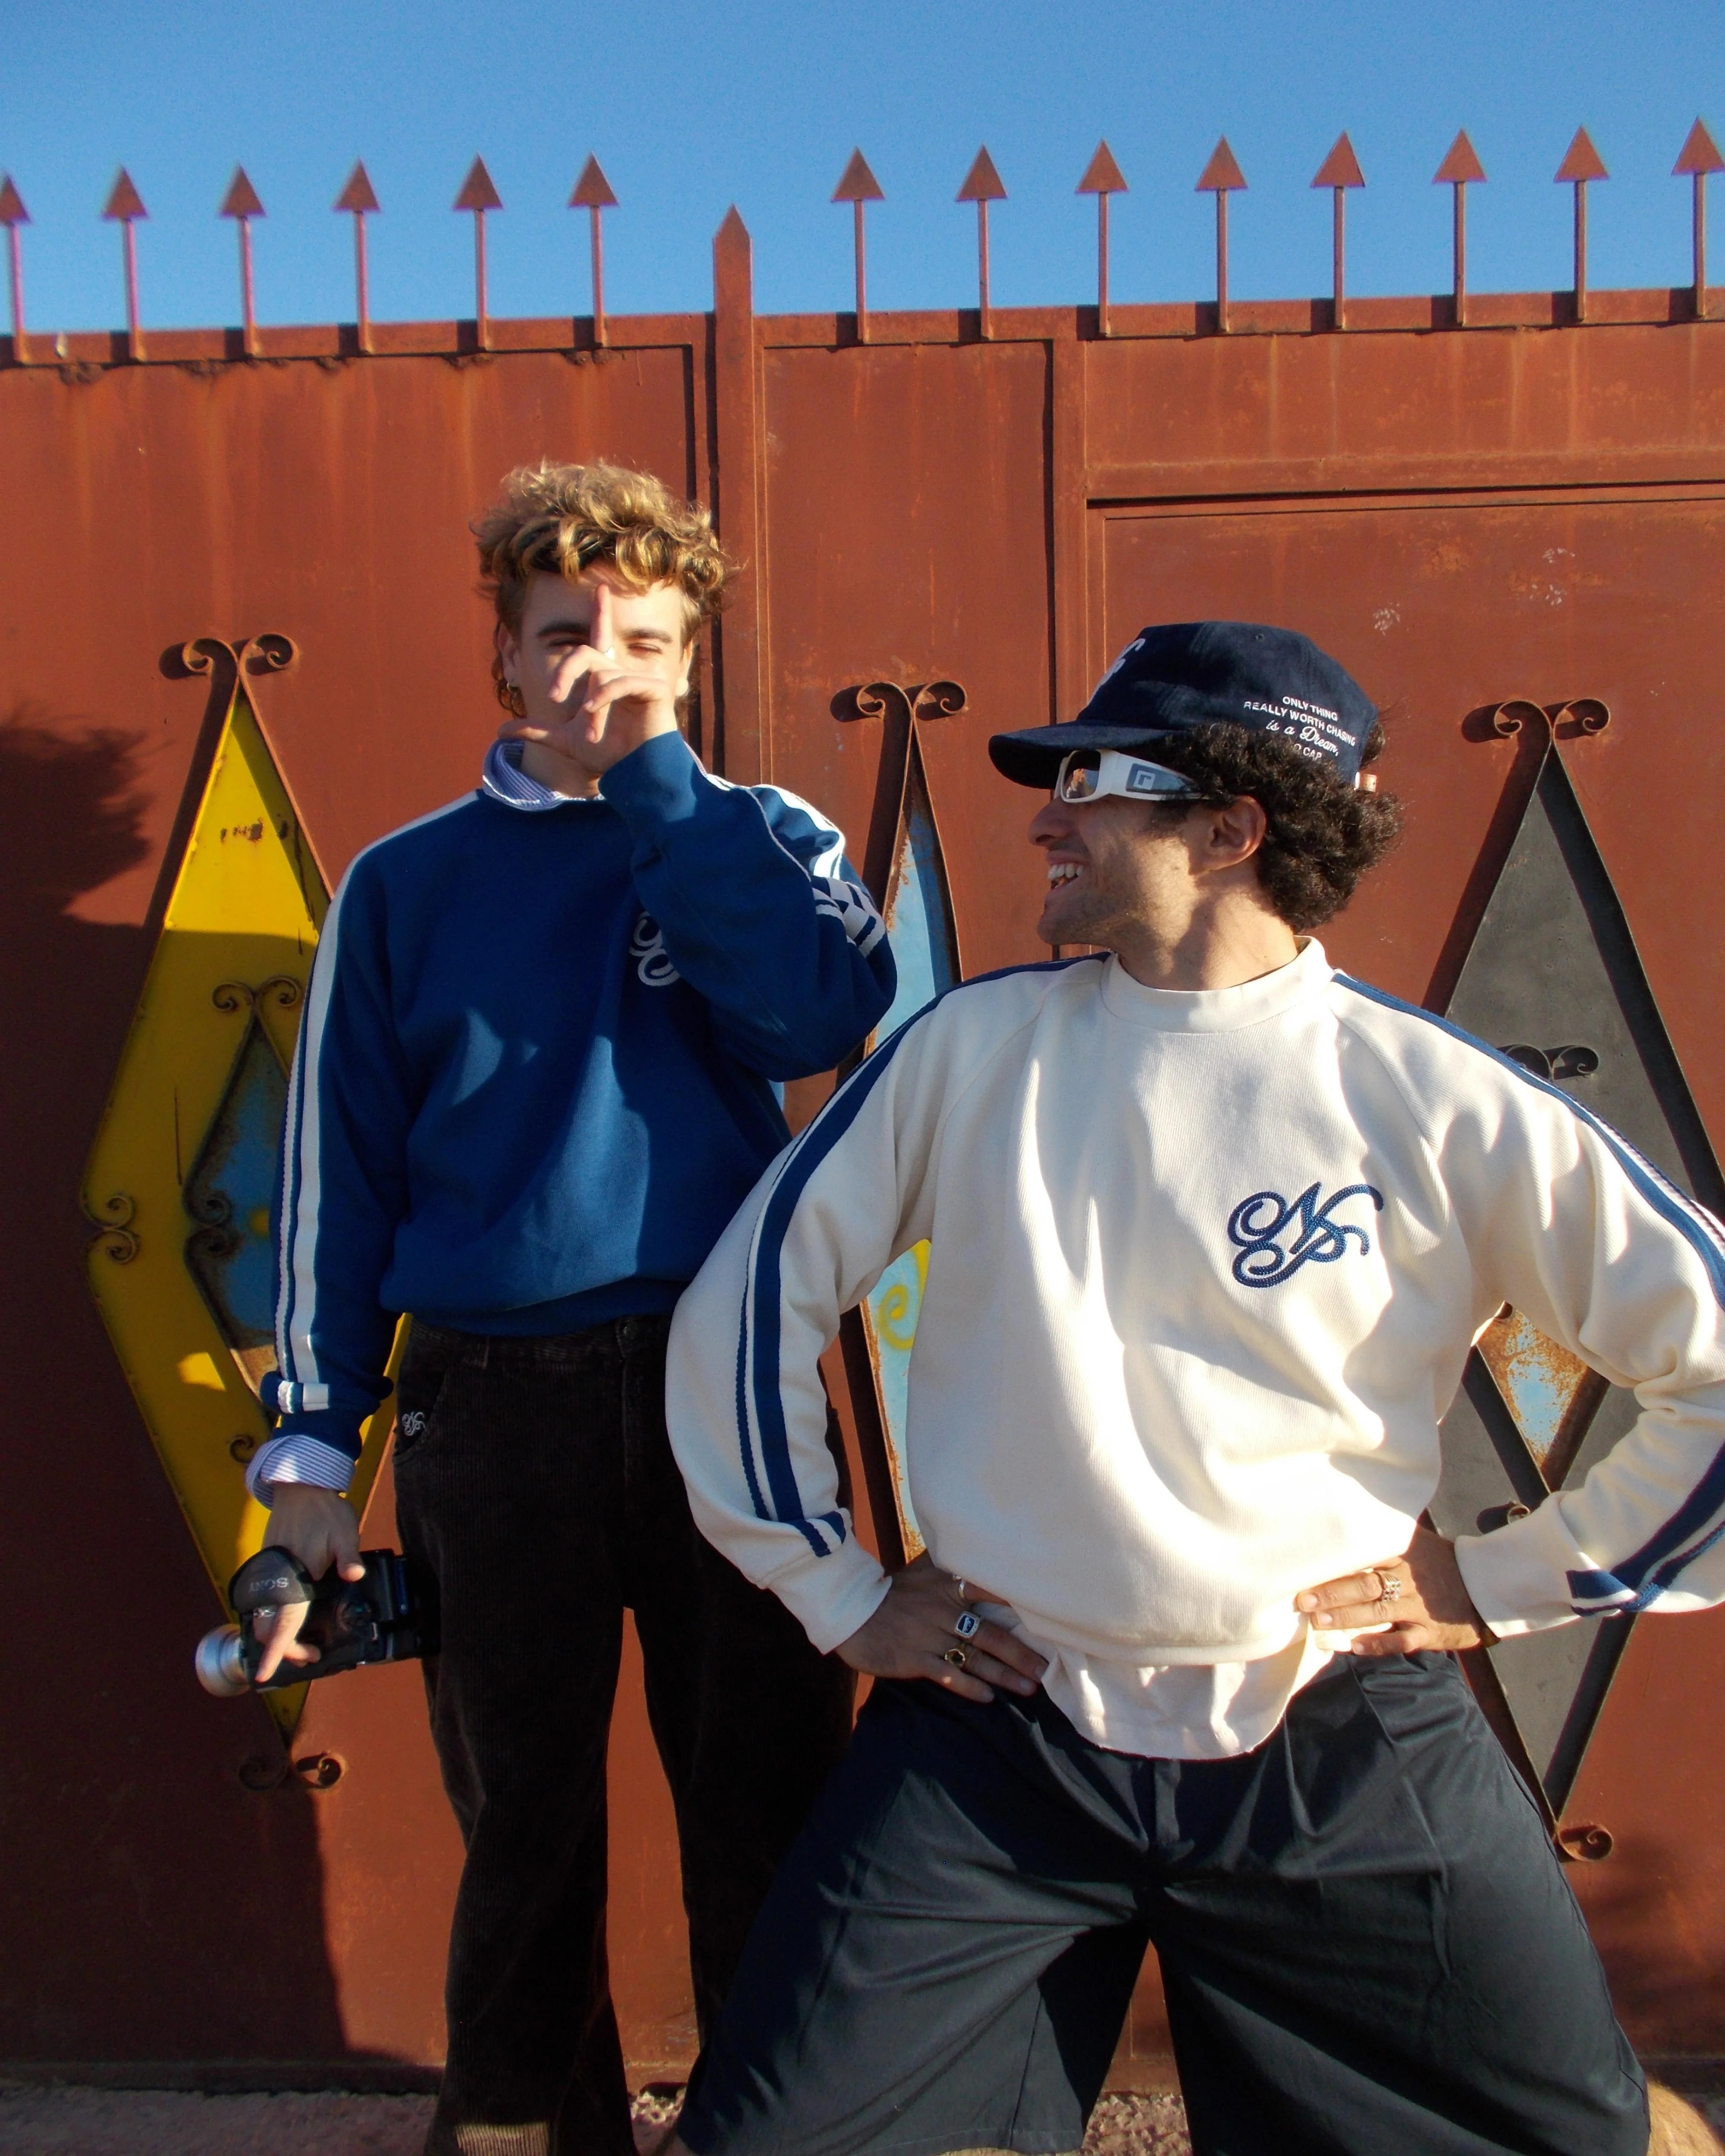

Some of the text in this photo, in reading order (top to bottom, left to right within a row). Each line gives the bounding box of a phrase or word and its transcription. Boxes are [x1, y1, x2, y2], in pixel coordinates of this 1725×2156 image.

[1243, 701, 1356, 747] REALLY WORTH CHASING
[1282, 696, 1338, 721] ONLY THING
[1266, 719, 1339, 756] is a Dream,
[1303, 747, 1322, 761] CAP
